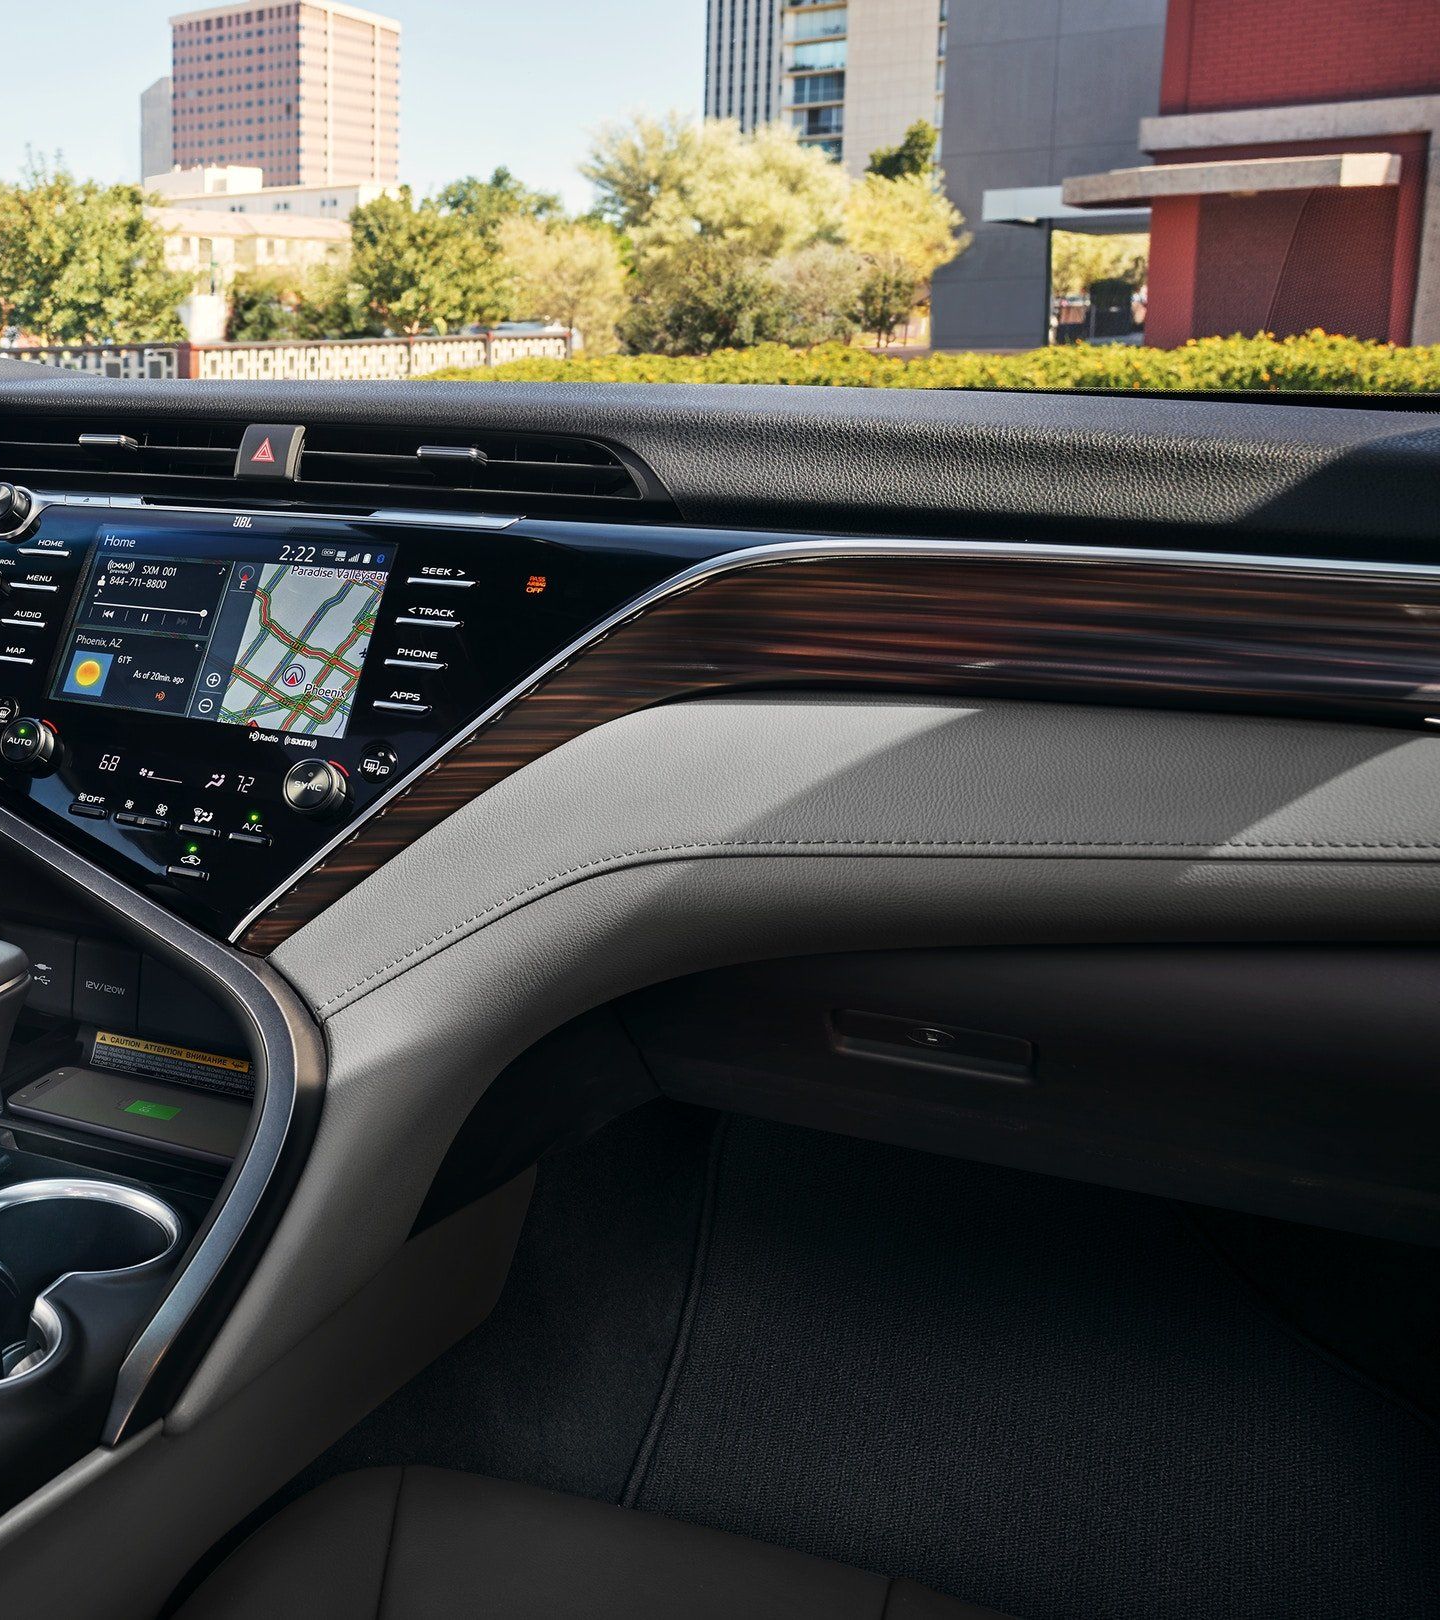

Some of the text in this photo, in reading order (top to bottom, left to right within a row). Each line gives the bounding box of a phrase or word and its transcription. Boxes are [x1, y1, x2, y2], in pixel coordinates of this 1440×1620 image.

[233, 516, 252, 528] JBL
[37, 539, 64, 547] HOME
[104, 535, 135, 548] Home
[279, 545, 316, 563] 2:22
[141, 565, 177, 576] SXM 001
[291, 566, 333, 578] Paradise
[421, 566, 452, 576] SEEK
[26, 574, 52, 583] MENU
[110, 576, 167, 589] 844-711-8800
[239, 581, 246, 590] E
[13, 610, 42, 619] AUDIO
[418, 607, 455, 618] TRACK
[76, 634, 123, 648] Phoenix, AZ
[5, 646, 26, 654] MAP
[396, 648, 439, 660] PHONE
[133, 670, 142, 679] As
[142, 672, 152, 680] of
[172, 676, 185, 685] ago
[304, 683, 347, 699] Phoenix
[389, 690, 422, 702] APPS
[6, 736, 33, 747] AUTO
[259, 733, 279, 743] Radio
[98, 754, 121, 772] 68
[236, 775, 256, 794] 72
[293, 779, 323, 792] SYNC
[86, 794, 106, 804] OFF
[242, 822, 263, 833] A/C
[85, 980, 126, 996] 12V/120W
[110, 1036, 141, 1048] CAUTION
[143, 1043, 183, 1057] ATTENTION
[186, 1051, 228, 1066] ВНИМАНИЕ
